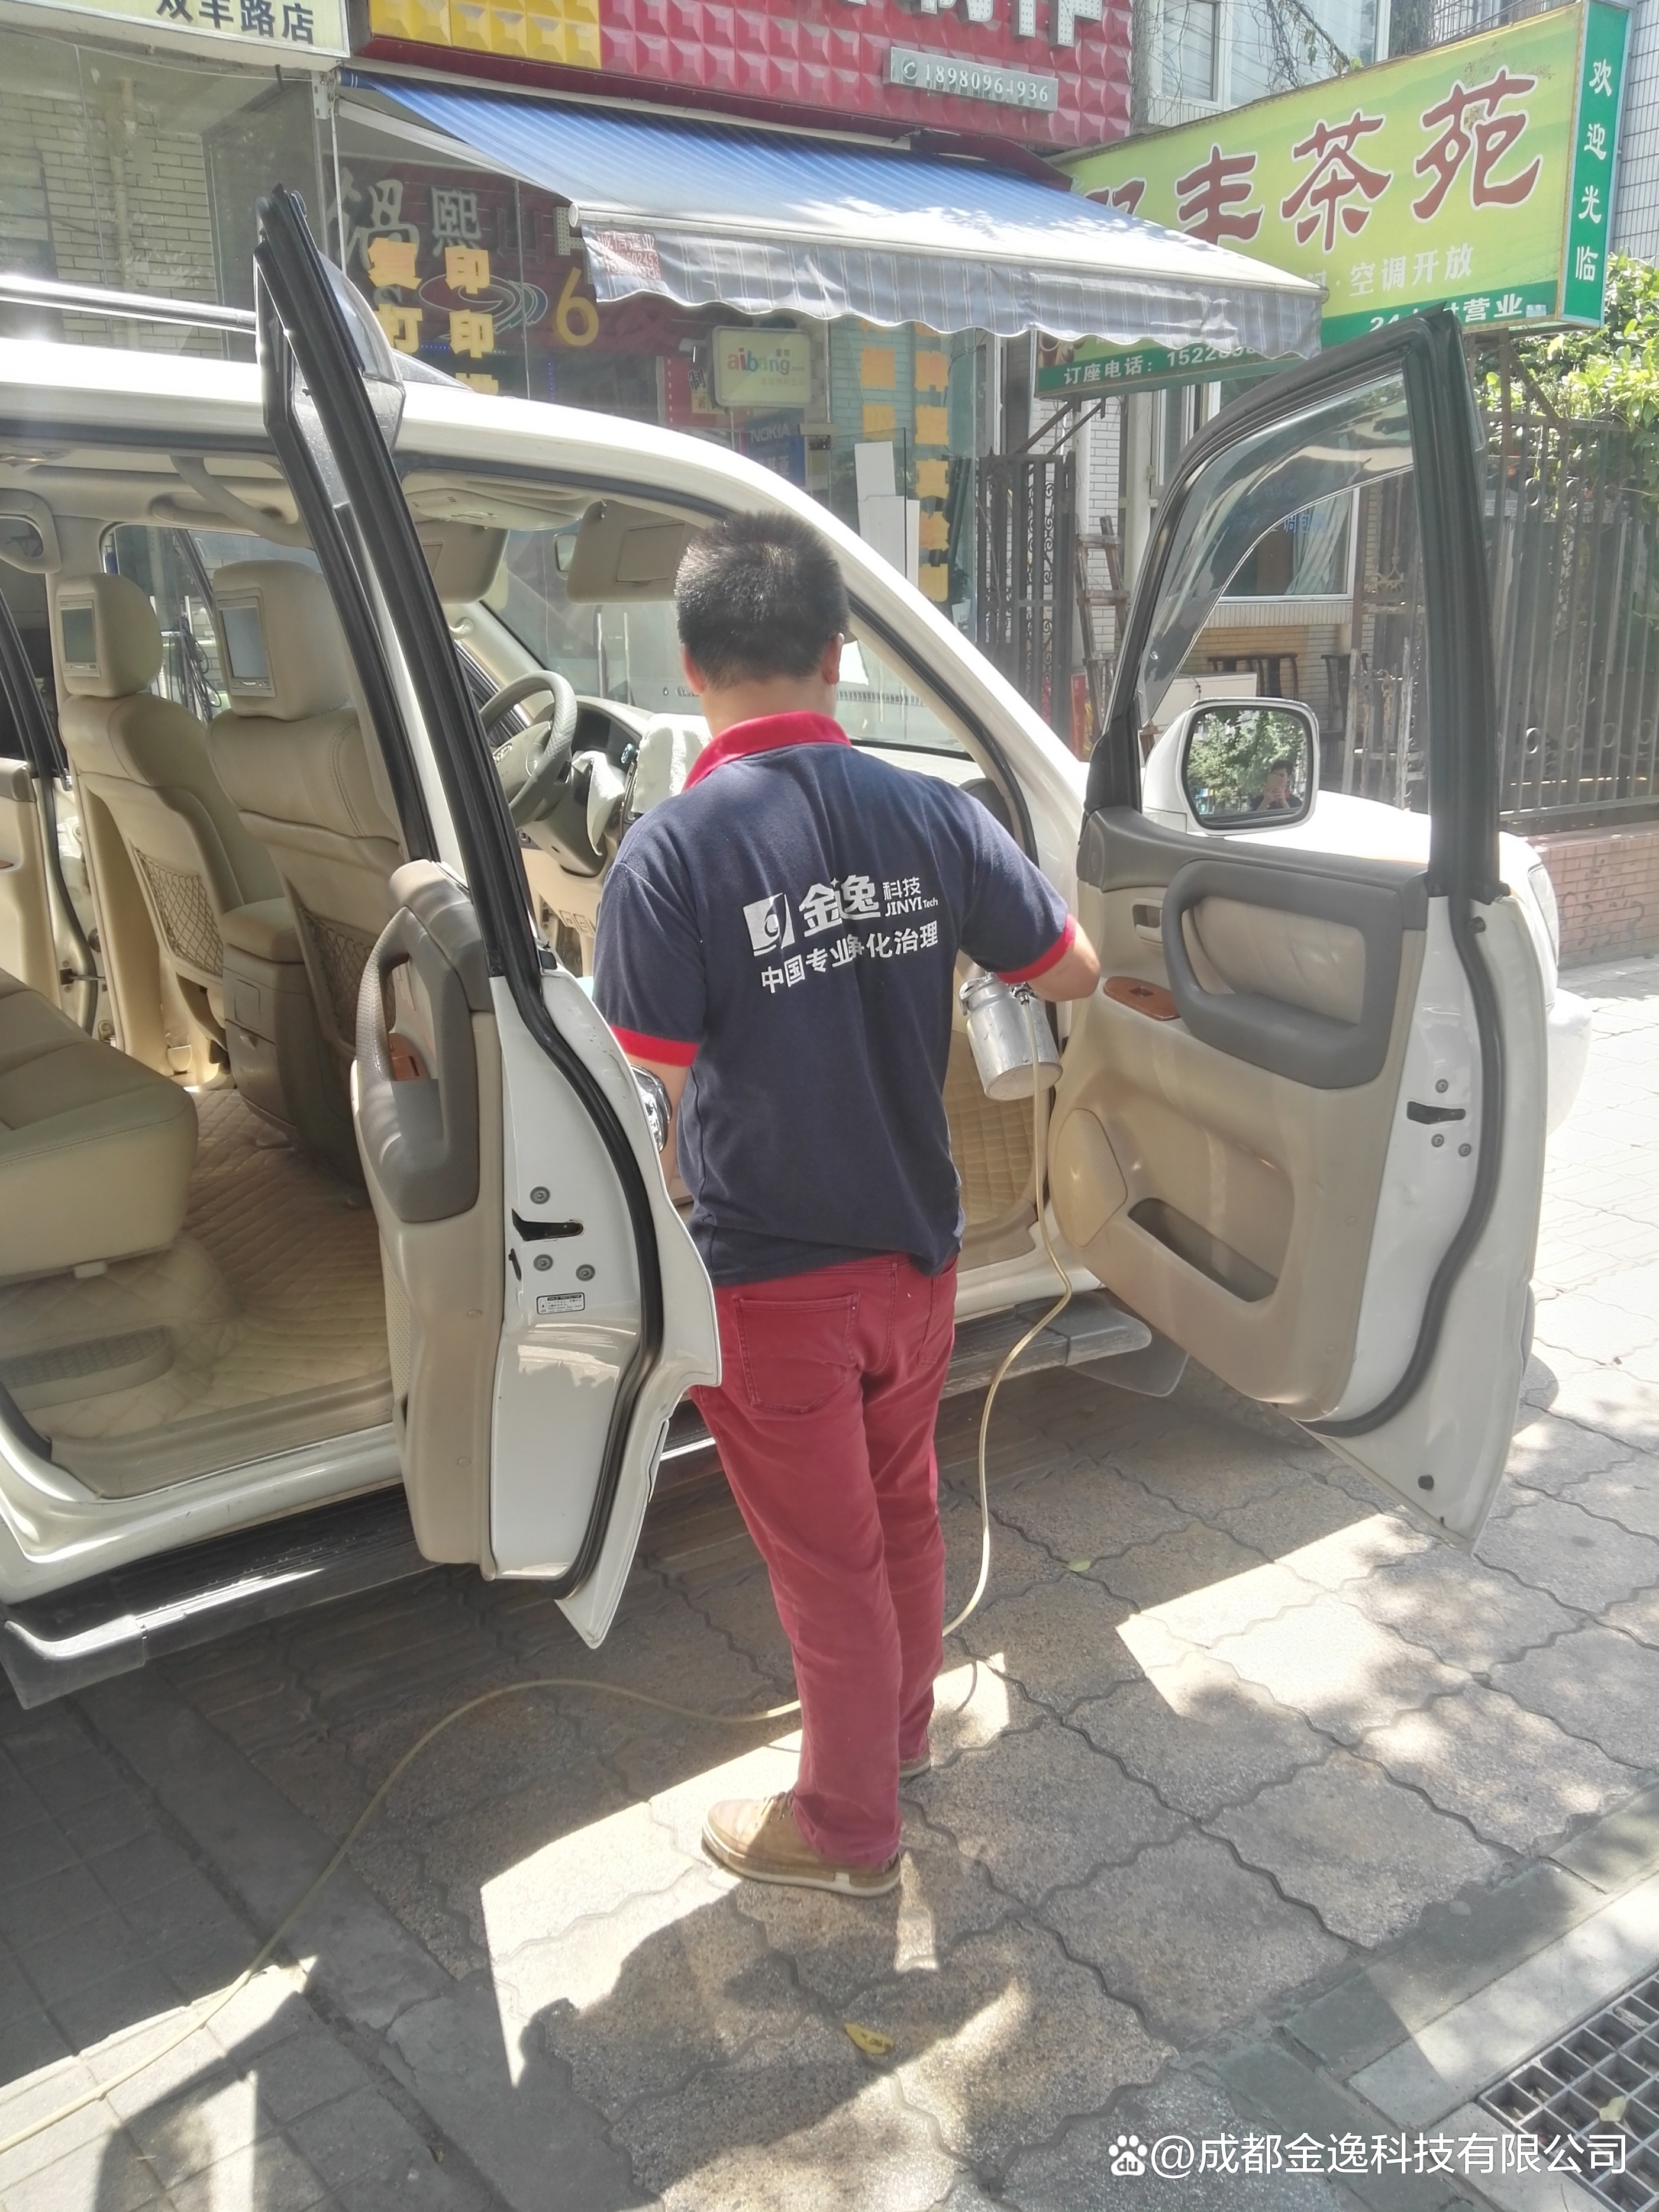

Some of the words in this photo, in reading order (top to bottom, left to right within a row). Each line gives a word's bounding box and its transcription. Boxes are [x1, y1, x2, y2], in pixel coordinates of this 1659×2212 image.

[1574, 59, 1613, 282] 欢迎光临
[1350, 243, 1474, 296] 空调开放
[1369, 294, 1522, 332] 2营业
[750, 423, 790, 443] NOKIA
[756, 455, 790, 475] 基亚
[799, 875, 881, 937] 金逸
[882, 876, 921, 901] 科技
[761, 920, 938, 994] 中国专业净化治理
